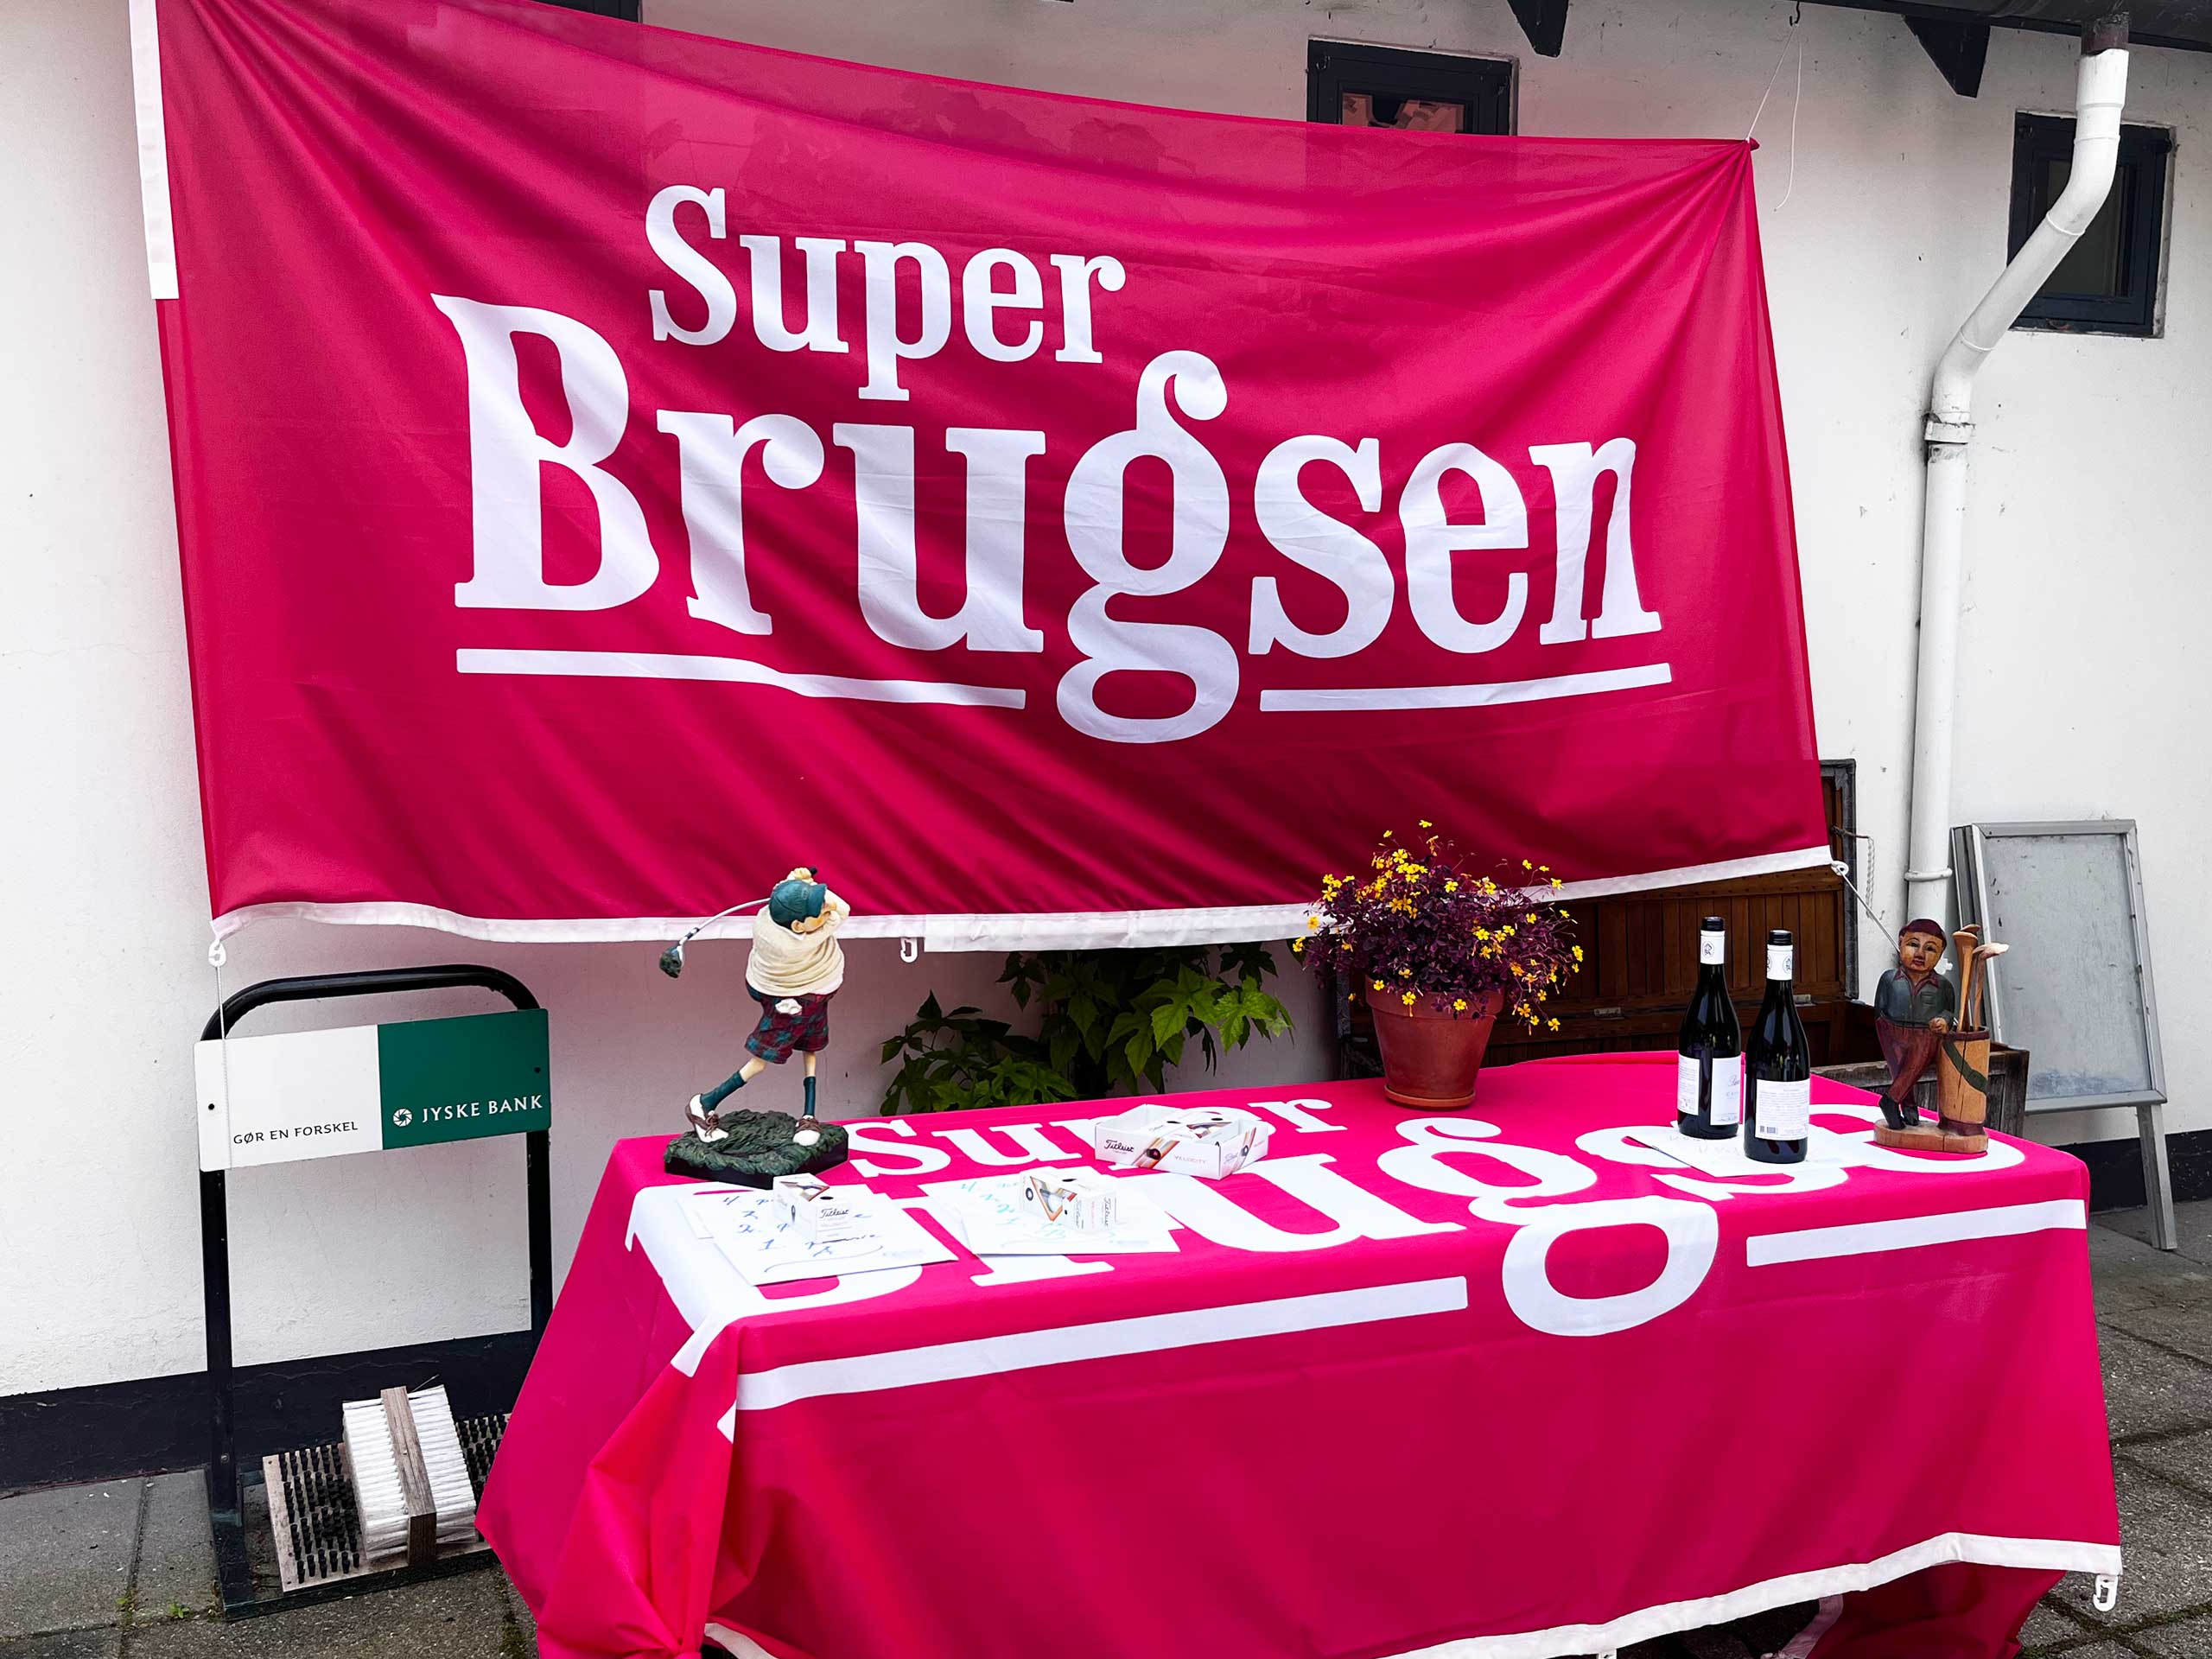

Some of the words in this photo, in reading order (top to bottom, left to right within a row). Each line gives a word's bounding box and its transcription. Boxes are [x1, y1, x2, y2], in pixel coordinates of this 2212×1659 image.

[645, 185, 1126, 403] Super
[430, 292, 1664, 743] Brugsen
[232, 1130, 265, 1146] GØR
[270, 1128, 289, 1141] EN
[294, 1121, 359, 1138] FORSKEL
[421, 1102, 481, 1124] JYSKE
[487, 1094, 543, 1116] BANK
[843, 1098, 1348, 1178] Sur
